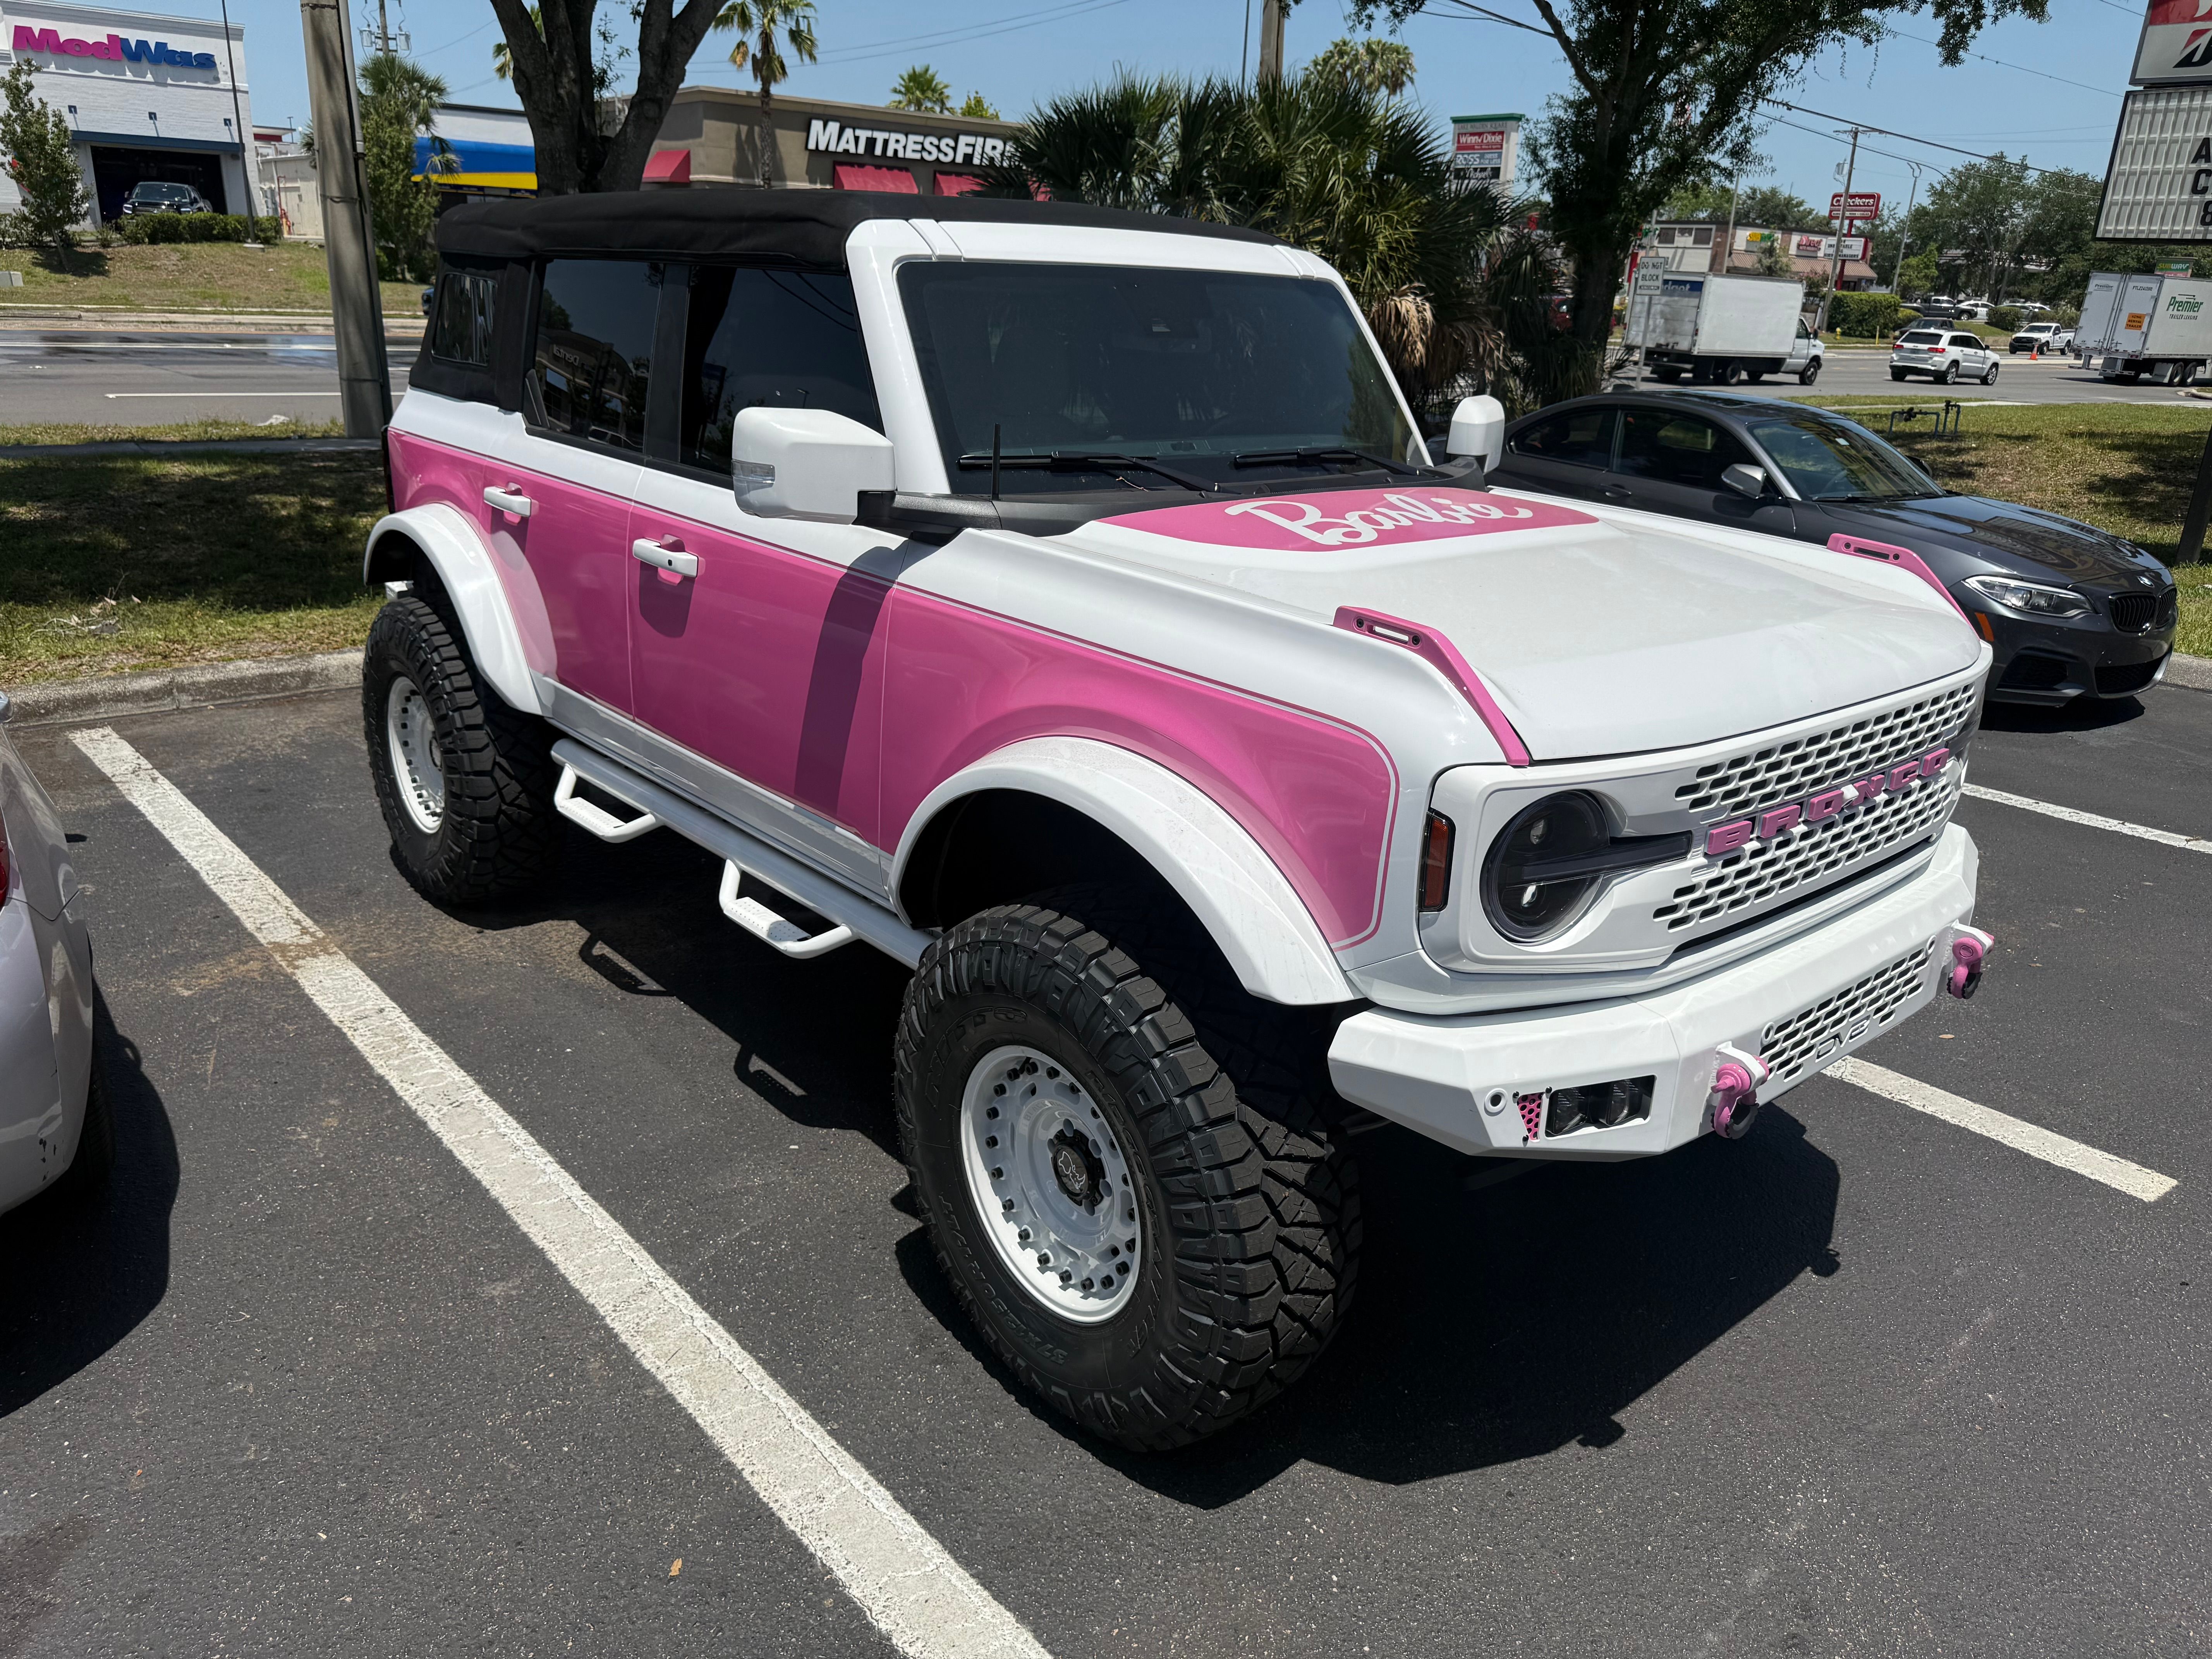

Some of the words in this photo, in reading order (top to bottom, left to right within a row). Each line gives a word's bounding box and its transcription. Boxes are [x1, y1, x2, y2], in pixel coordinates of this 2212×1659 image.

[12, 25, 217, 70] ModWas
[2166, 296, 2204, 313] Premier
[1224, 494, 1533, 545] Barbie
[1705, 748, 1950, 855] BRONCO
